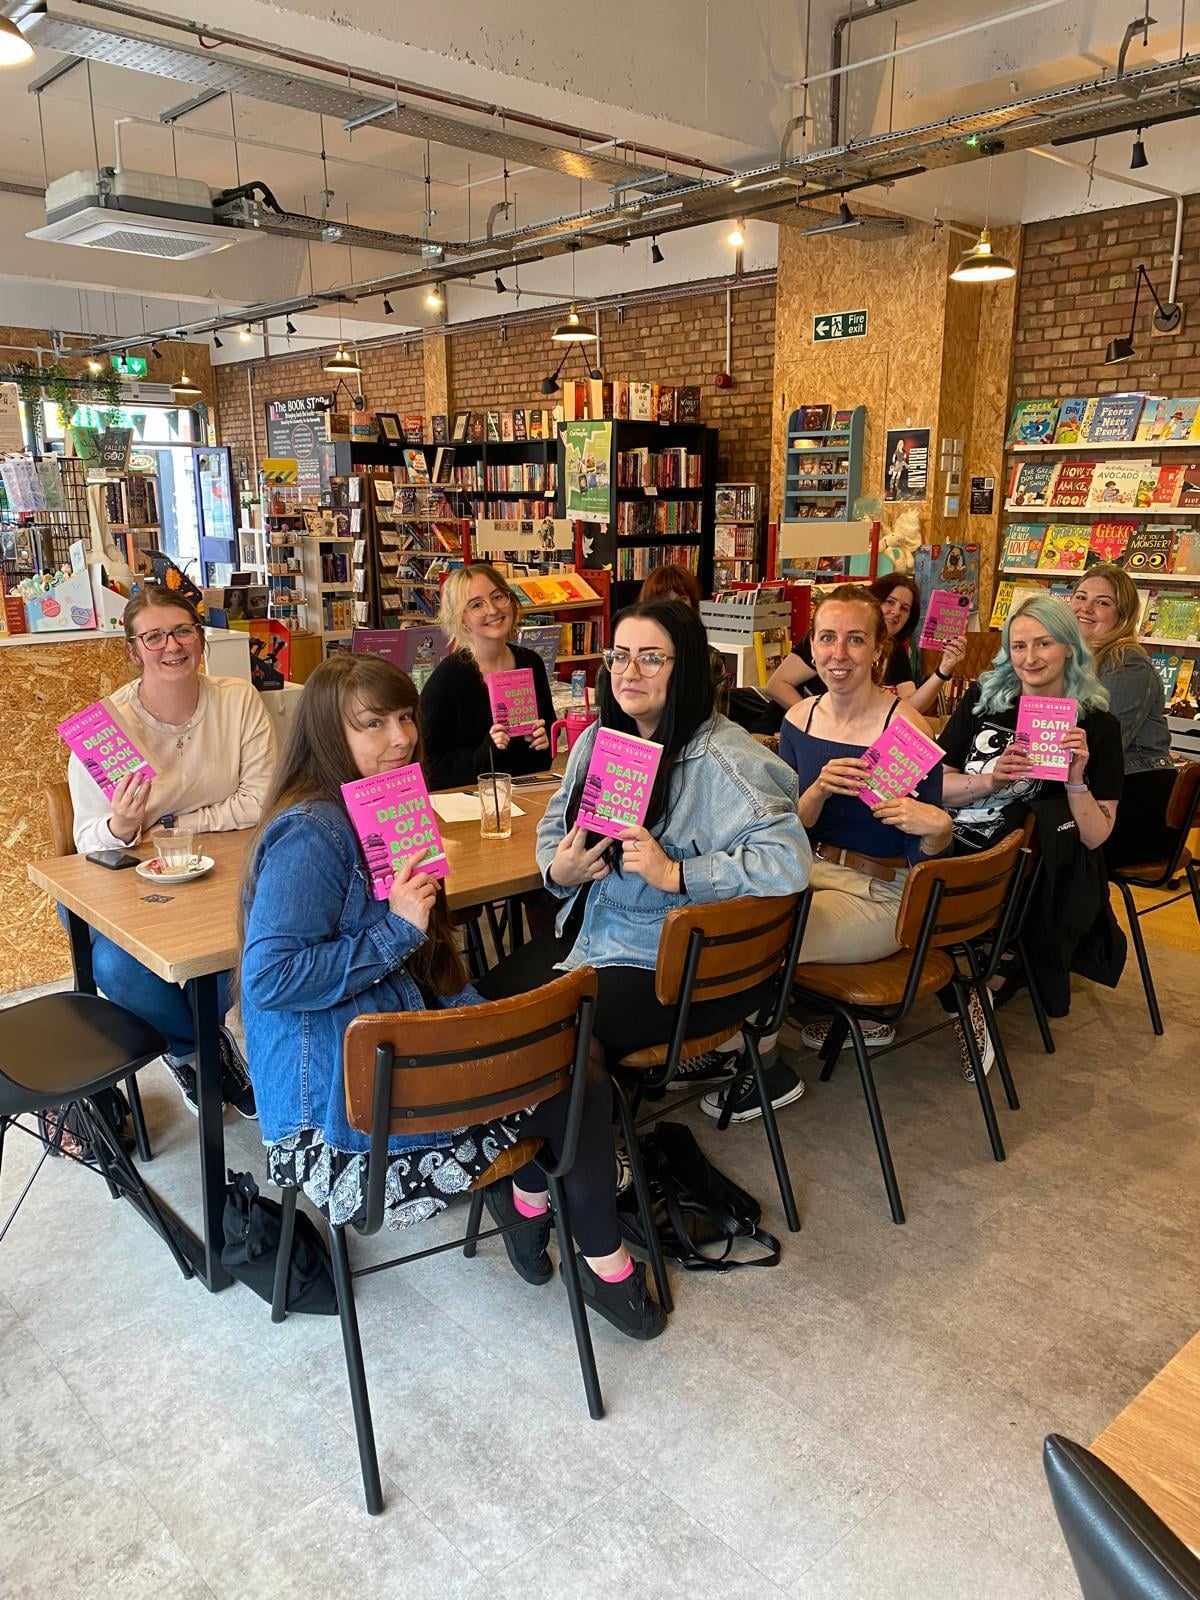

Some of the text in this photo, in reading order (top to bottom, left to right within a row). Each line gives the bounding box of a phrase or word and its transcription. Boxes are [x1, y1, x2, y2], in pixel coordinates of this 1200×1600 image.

[848, 314, 865, 325] Fire
[848, 324, 864, 334] exit
[273, 401, 287, 412] The
[287, 399, 306, 411] BOOK
[1101, 407, 1135, 417] PEOPLE
[1101, 417, 1127, 427] NEED
[1094, 426, 1128, 436] PEOPLE
[103, 451, 125, 461] GOD
[907, 447, 928, 488] BRIGAND
[1097, 471, 1140, 480] AVOCADO
[1009, 541, 1026, 554] LOVE
[1031, 719, 1070, 731] DEATH
[83, 724, 118, 750] DEATH
[1040, 731, 1057, 741] OF
[99, 736, 127, 756] OF A
[101, 746, 134, 770] BOOK
[888, 746, 921, 777] DEATH
[1028, 753, 1066, 766] SELLER
[606, 762, 649, 784] DEATH
[889, 763, 905, 777] OF
[873, 767, 906, 793] BOOK
[613, 779, 644, 798] OF A
[602, 790, 642, 812] BOOK
[376, 796, 424, 823] DEATH
[596, 803, 638, 826] SELLER
[395, 813, 431, 834] OF A
[390, 829, 436, 854] BOOK
